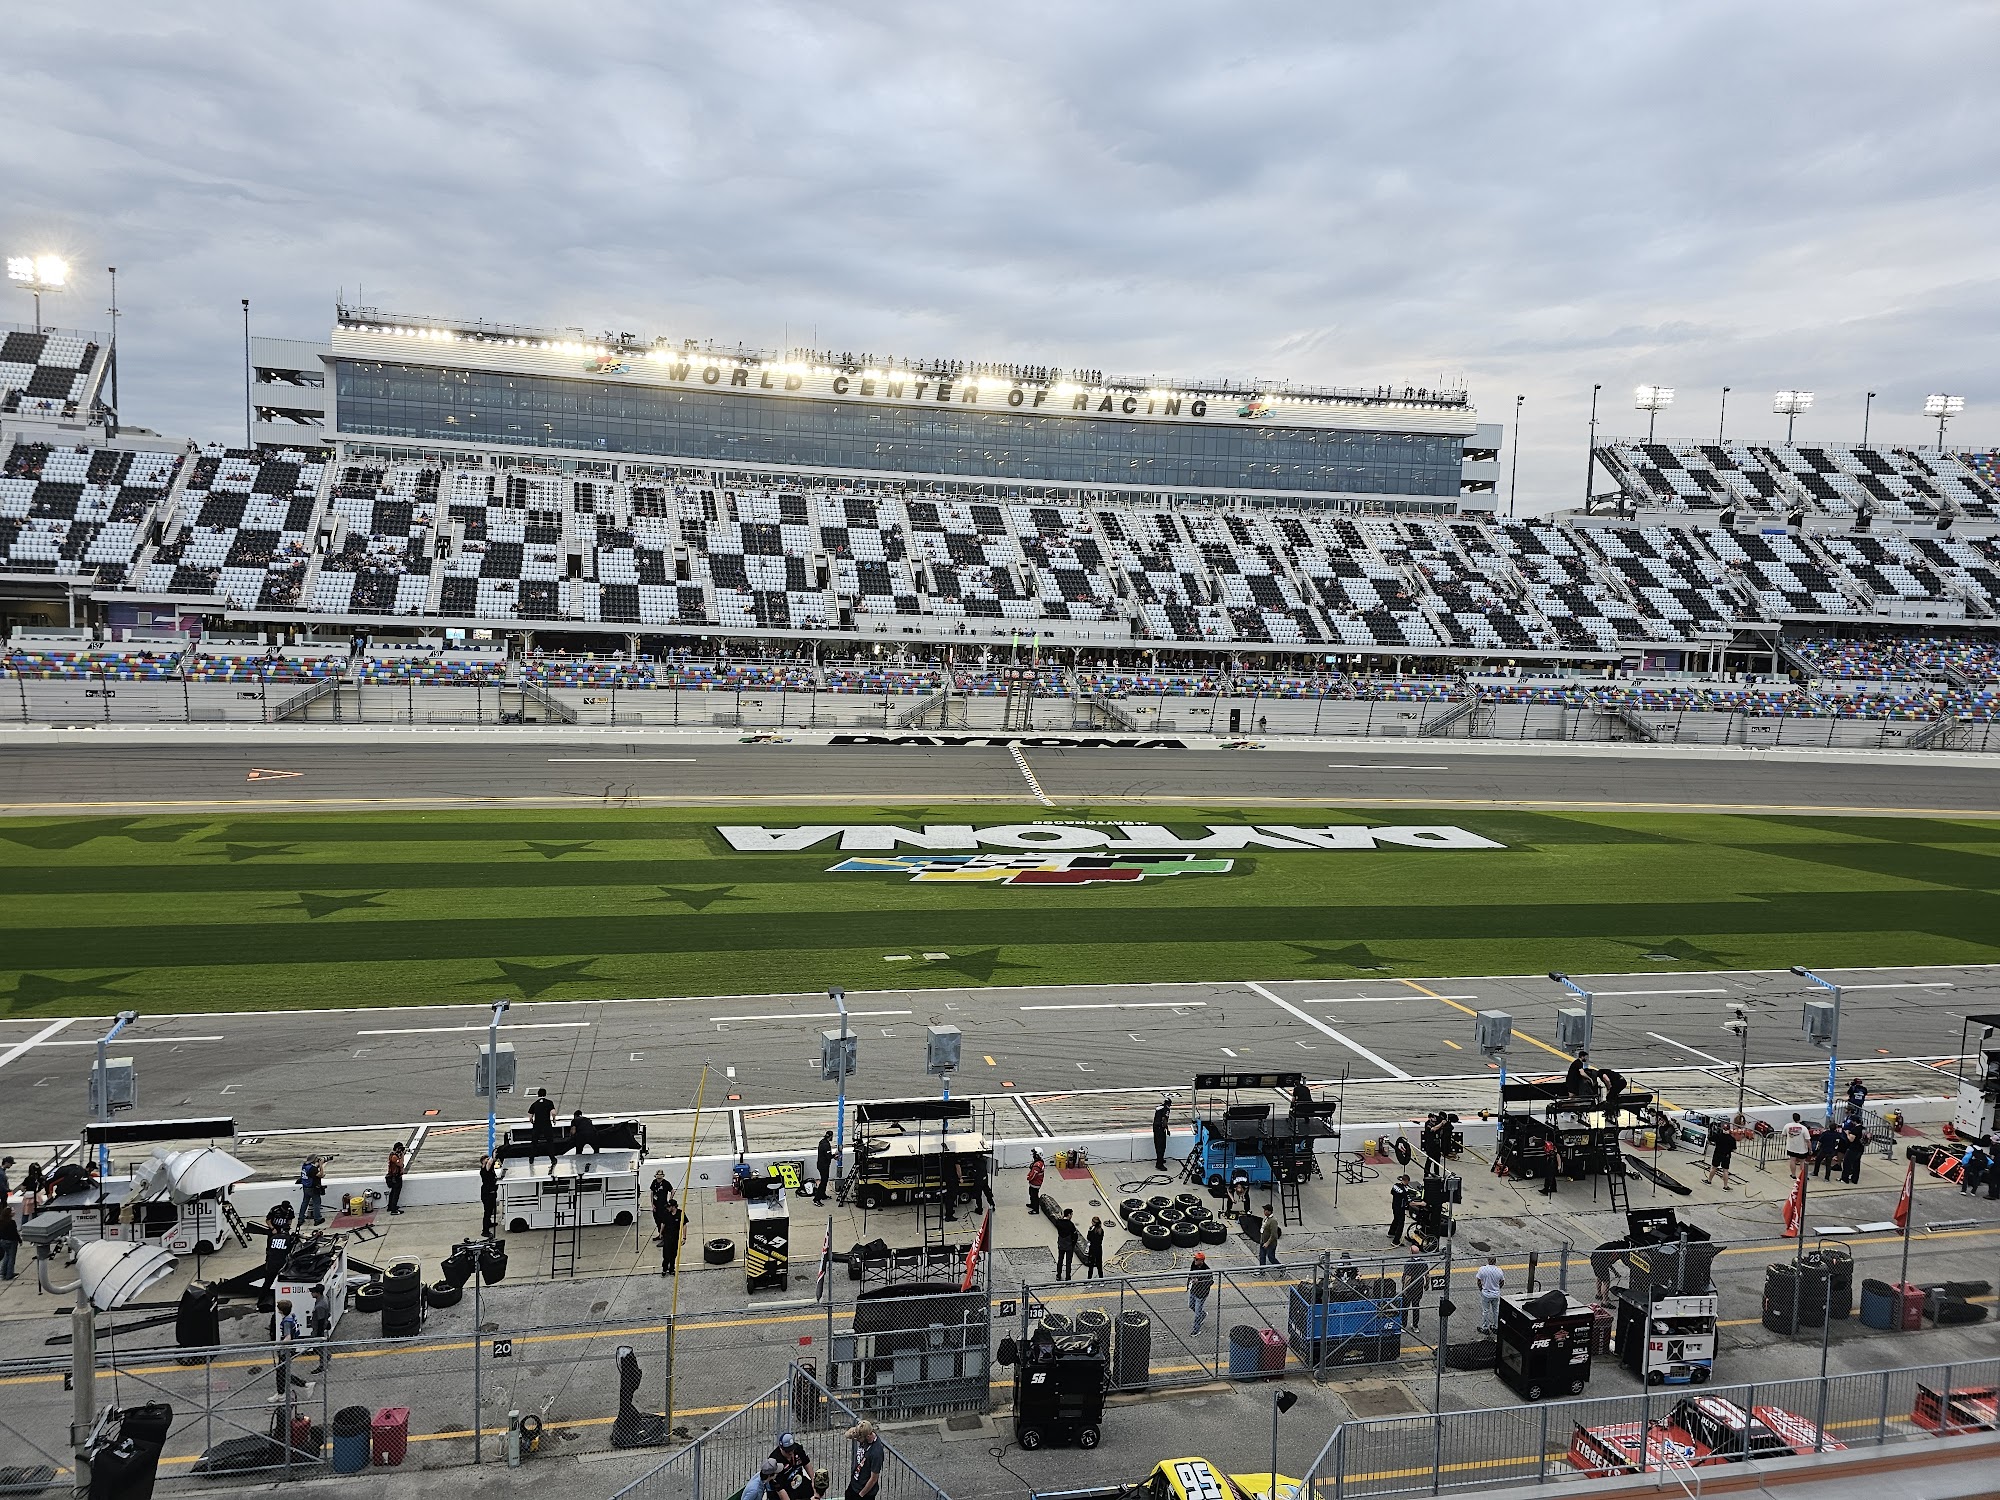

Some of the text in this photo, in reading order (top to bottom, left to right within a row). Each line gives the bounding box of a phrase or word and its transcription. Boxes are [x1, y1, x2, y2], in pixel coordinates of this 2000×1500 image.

[668, 362, 1208, 417] WORLD CENTER OF RACING
[826, 735, 1188, 749] DAYTONA
[716, 824, 1508, 851] DAYTONA
[187, 1202, 213, 1216] JBL
[271, 1238, 288, 1250] JBL
[1809, 1254, 1821, 1263] 23
[1432, 1278, 1446, 1288] 22
[292, 1286, 306, 1294] JBL
[1002, 1303, 1014, 1314] 21
[1029, 1309, 1043, 1318] 136
[494, 1342, 512, 1354] 20
[1530, 1338, 1552, 1350] FRE
[1030, 1372, 1047, 1384] 56
[1700, 1415, 1718, 1432] BOYD
[1174, 1462, 1223, 1500] 95
